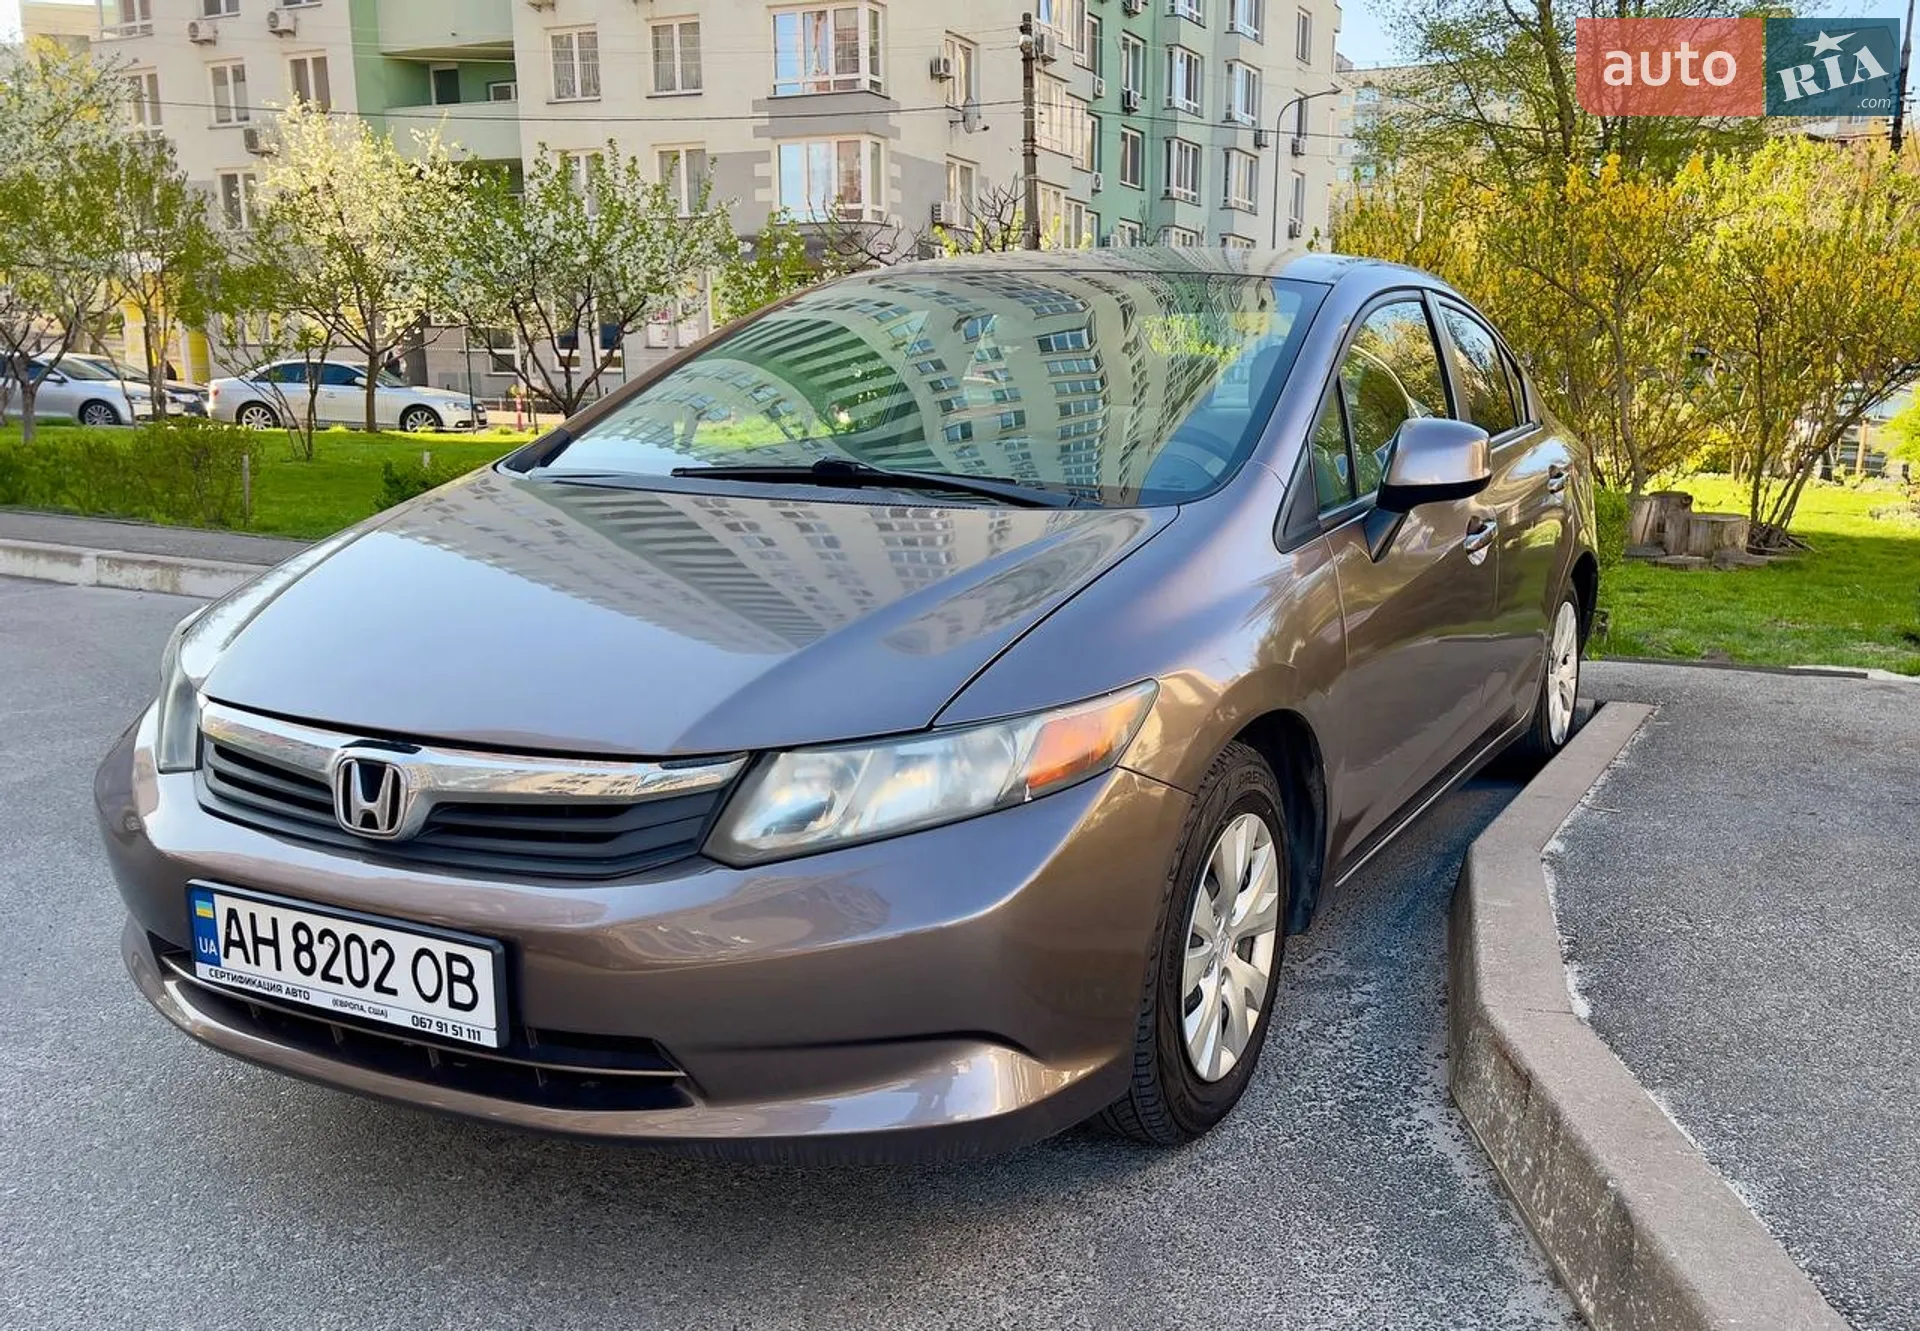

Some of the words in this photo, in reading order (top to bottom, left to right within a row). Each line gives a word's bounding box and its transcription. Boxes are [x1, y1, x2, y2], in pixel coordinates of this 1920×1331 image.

[199, 936, 218, 956] UA
[292, 921, 398, 996] 8202
[208, 968, 283, 994] СЕРТИФИКАЦИЯ
[285, 987, 310, 1001] АВТО
[411, 1015, 433, 1029] 067
[436, 1021, 448, 1034] 91
[451, 1024, 463, 1037] 51
[466, 1028, 481, 1041] 111
